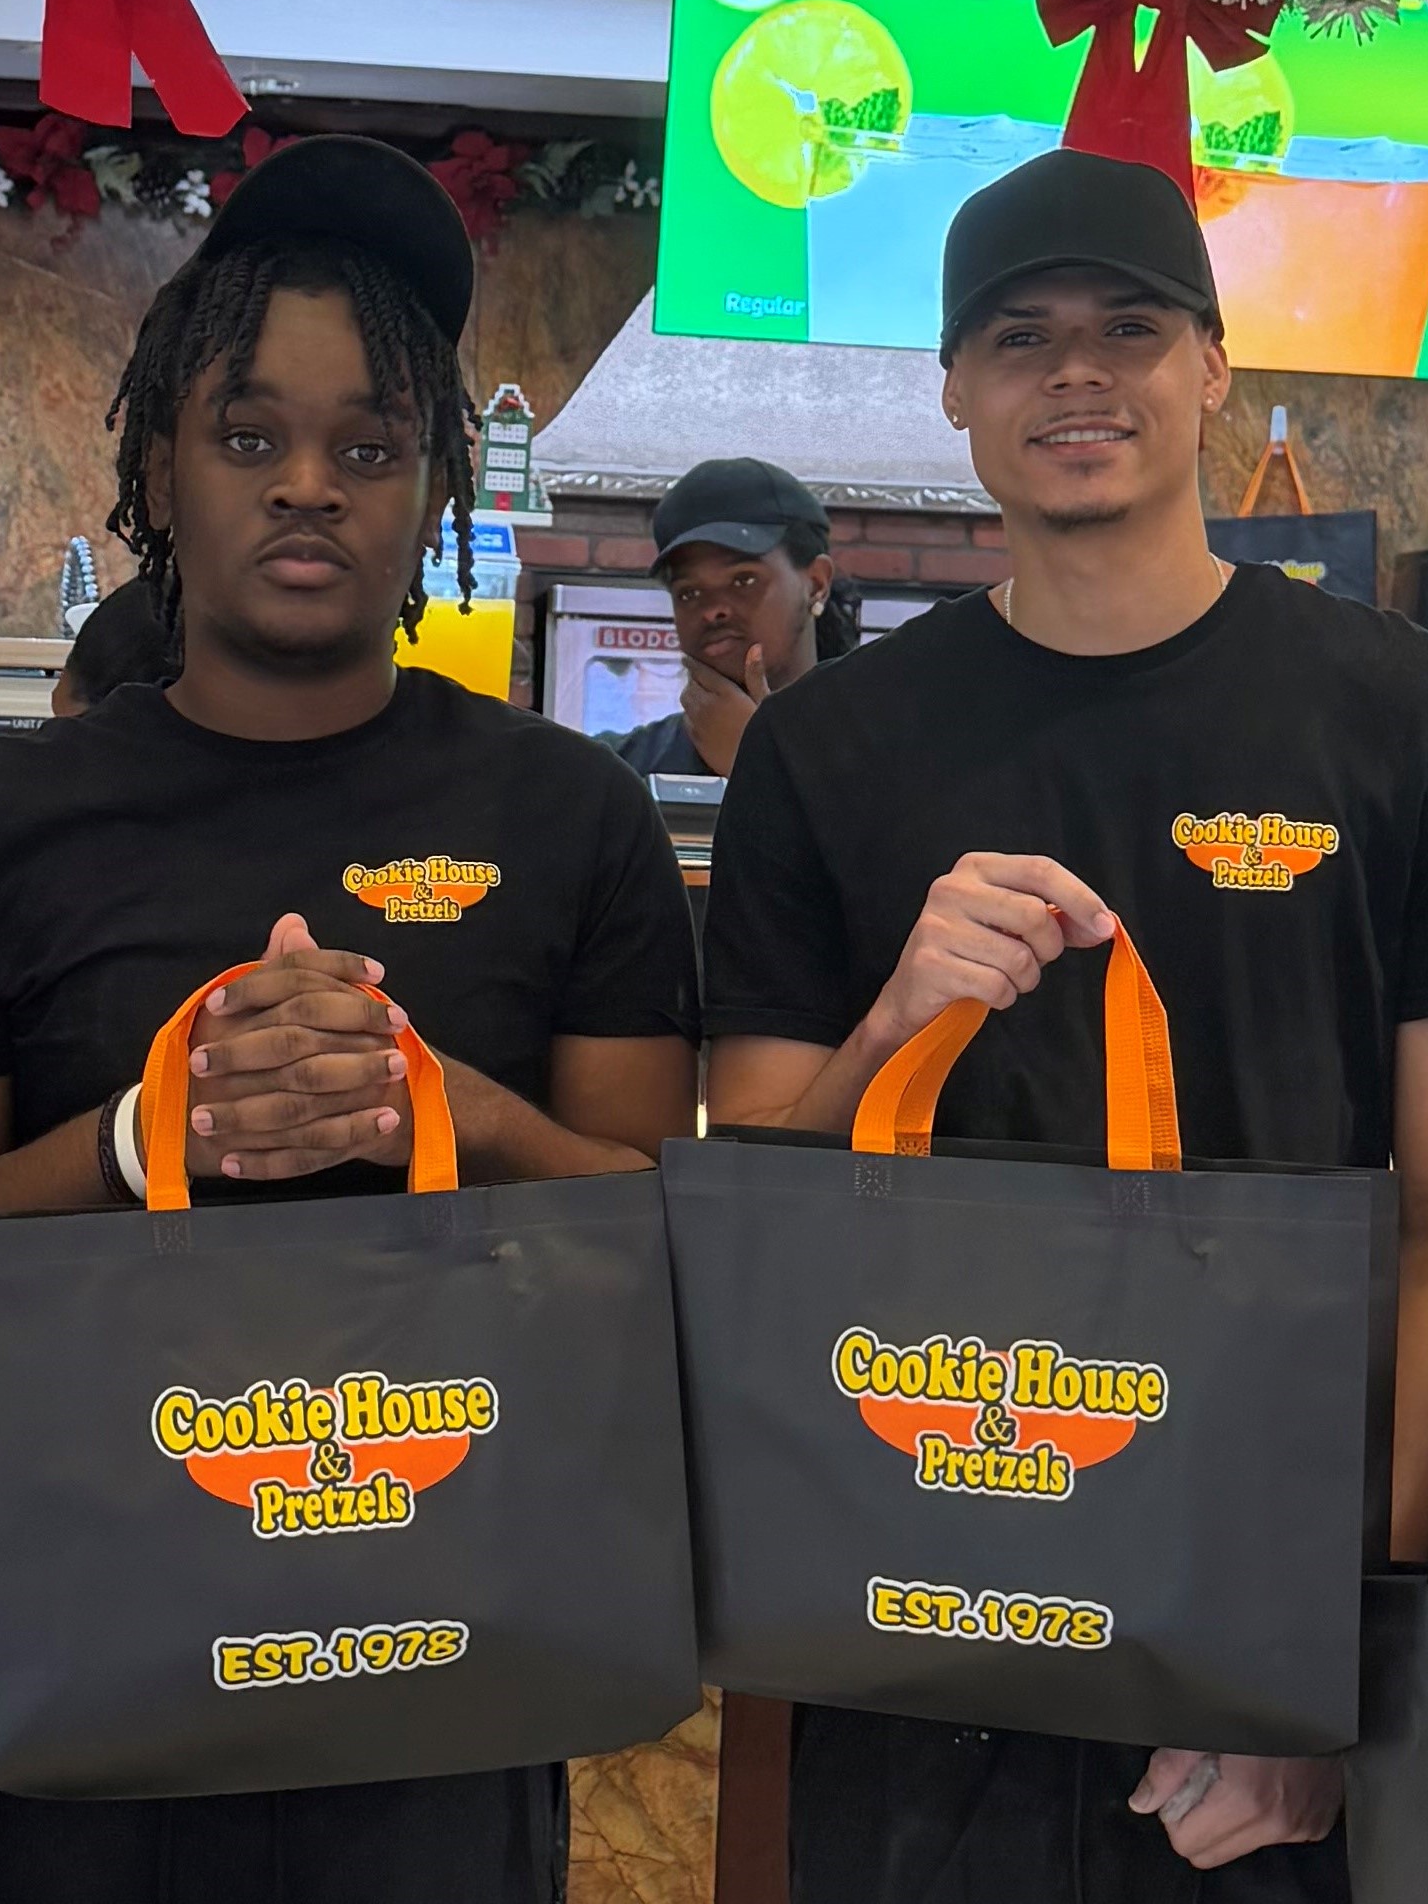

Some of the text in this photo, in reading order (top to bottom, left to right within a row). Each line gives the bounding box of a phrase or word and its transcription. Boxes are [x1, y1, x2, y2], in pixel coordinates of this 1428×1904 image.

[725, 292, 806, 317] Regular
[1175, 815, 1338, 851] Cookie House
[345, 857, 498, 892] Cookie House
[1215, 859, 1290, 887] Pretzels
[1243, 846, 1262, 865] &
[388, 897, 459, 920] Pretzels
[415, 883, 433, 900] &
[837, 1333, 1165, 1415] Cookie House
[157, 1378, 494, 1453] Cookie House
[979, 1405, 1013, 1444] &
[314, 1442, 348, 1480] &
[921, 1435, 1068, 1494] Pretzels
[255, 1474, 409, 1533] Pretzels
[873, 1586, 1105, 1644] EST.1978
[221, 1627, 464, 1683] EST.1978
